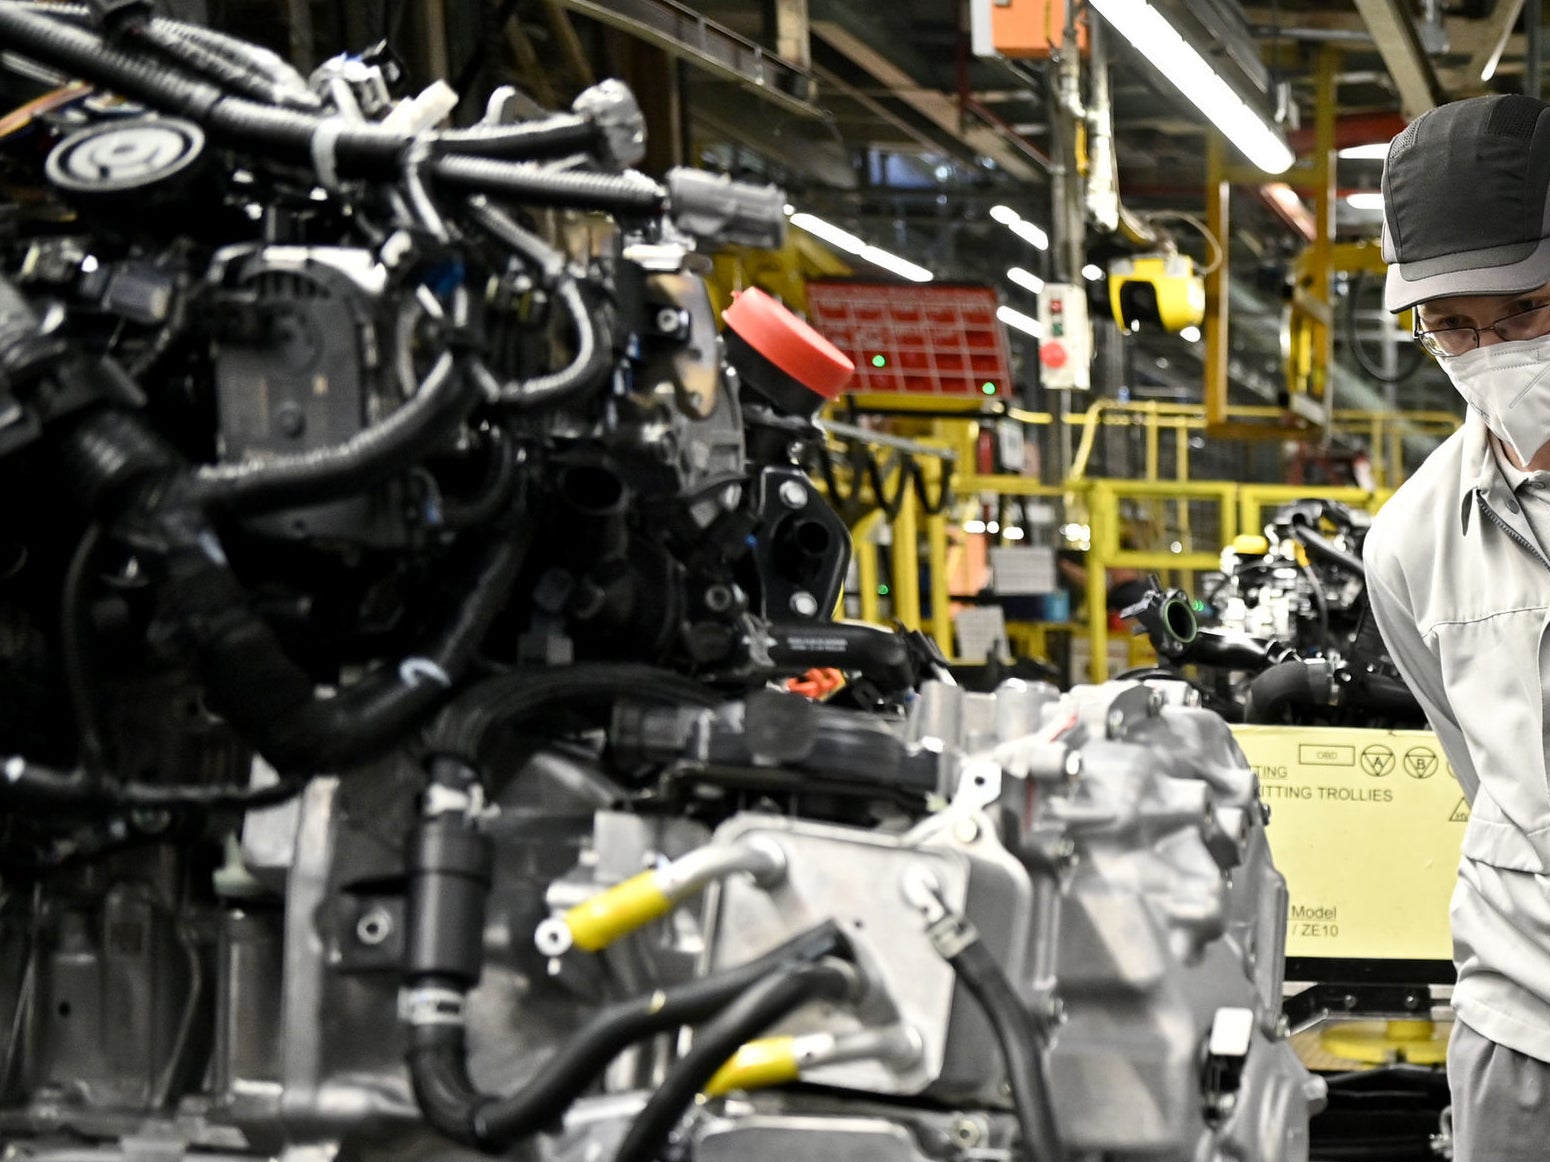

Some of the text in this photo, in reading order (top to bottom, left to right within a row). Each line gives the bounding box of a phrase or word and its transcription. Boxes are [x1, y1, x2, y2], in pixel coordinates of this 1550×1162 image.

[1374, 756, 1384, 768] A
[1416, 758, 1426, 770] B
[1248, 765, 1288, 779] TING
[1257, 784, 1394, 802] ITTING TROLLIES
[1292, 905, 1337, 919] Model
[1301, 924, 1339, 937] ZE10
